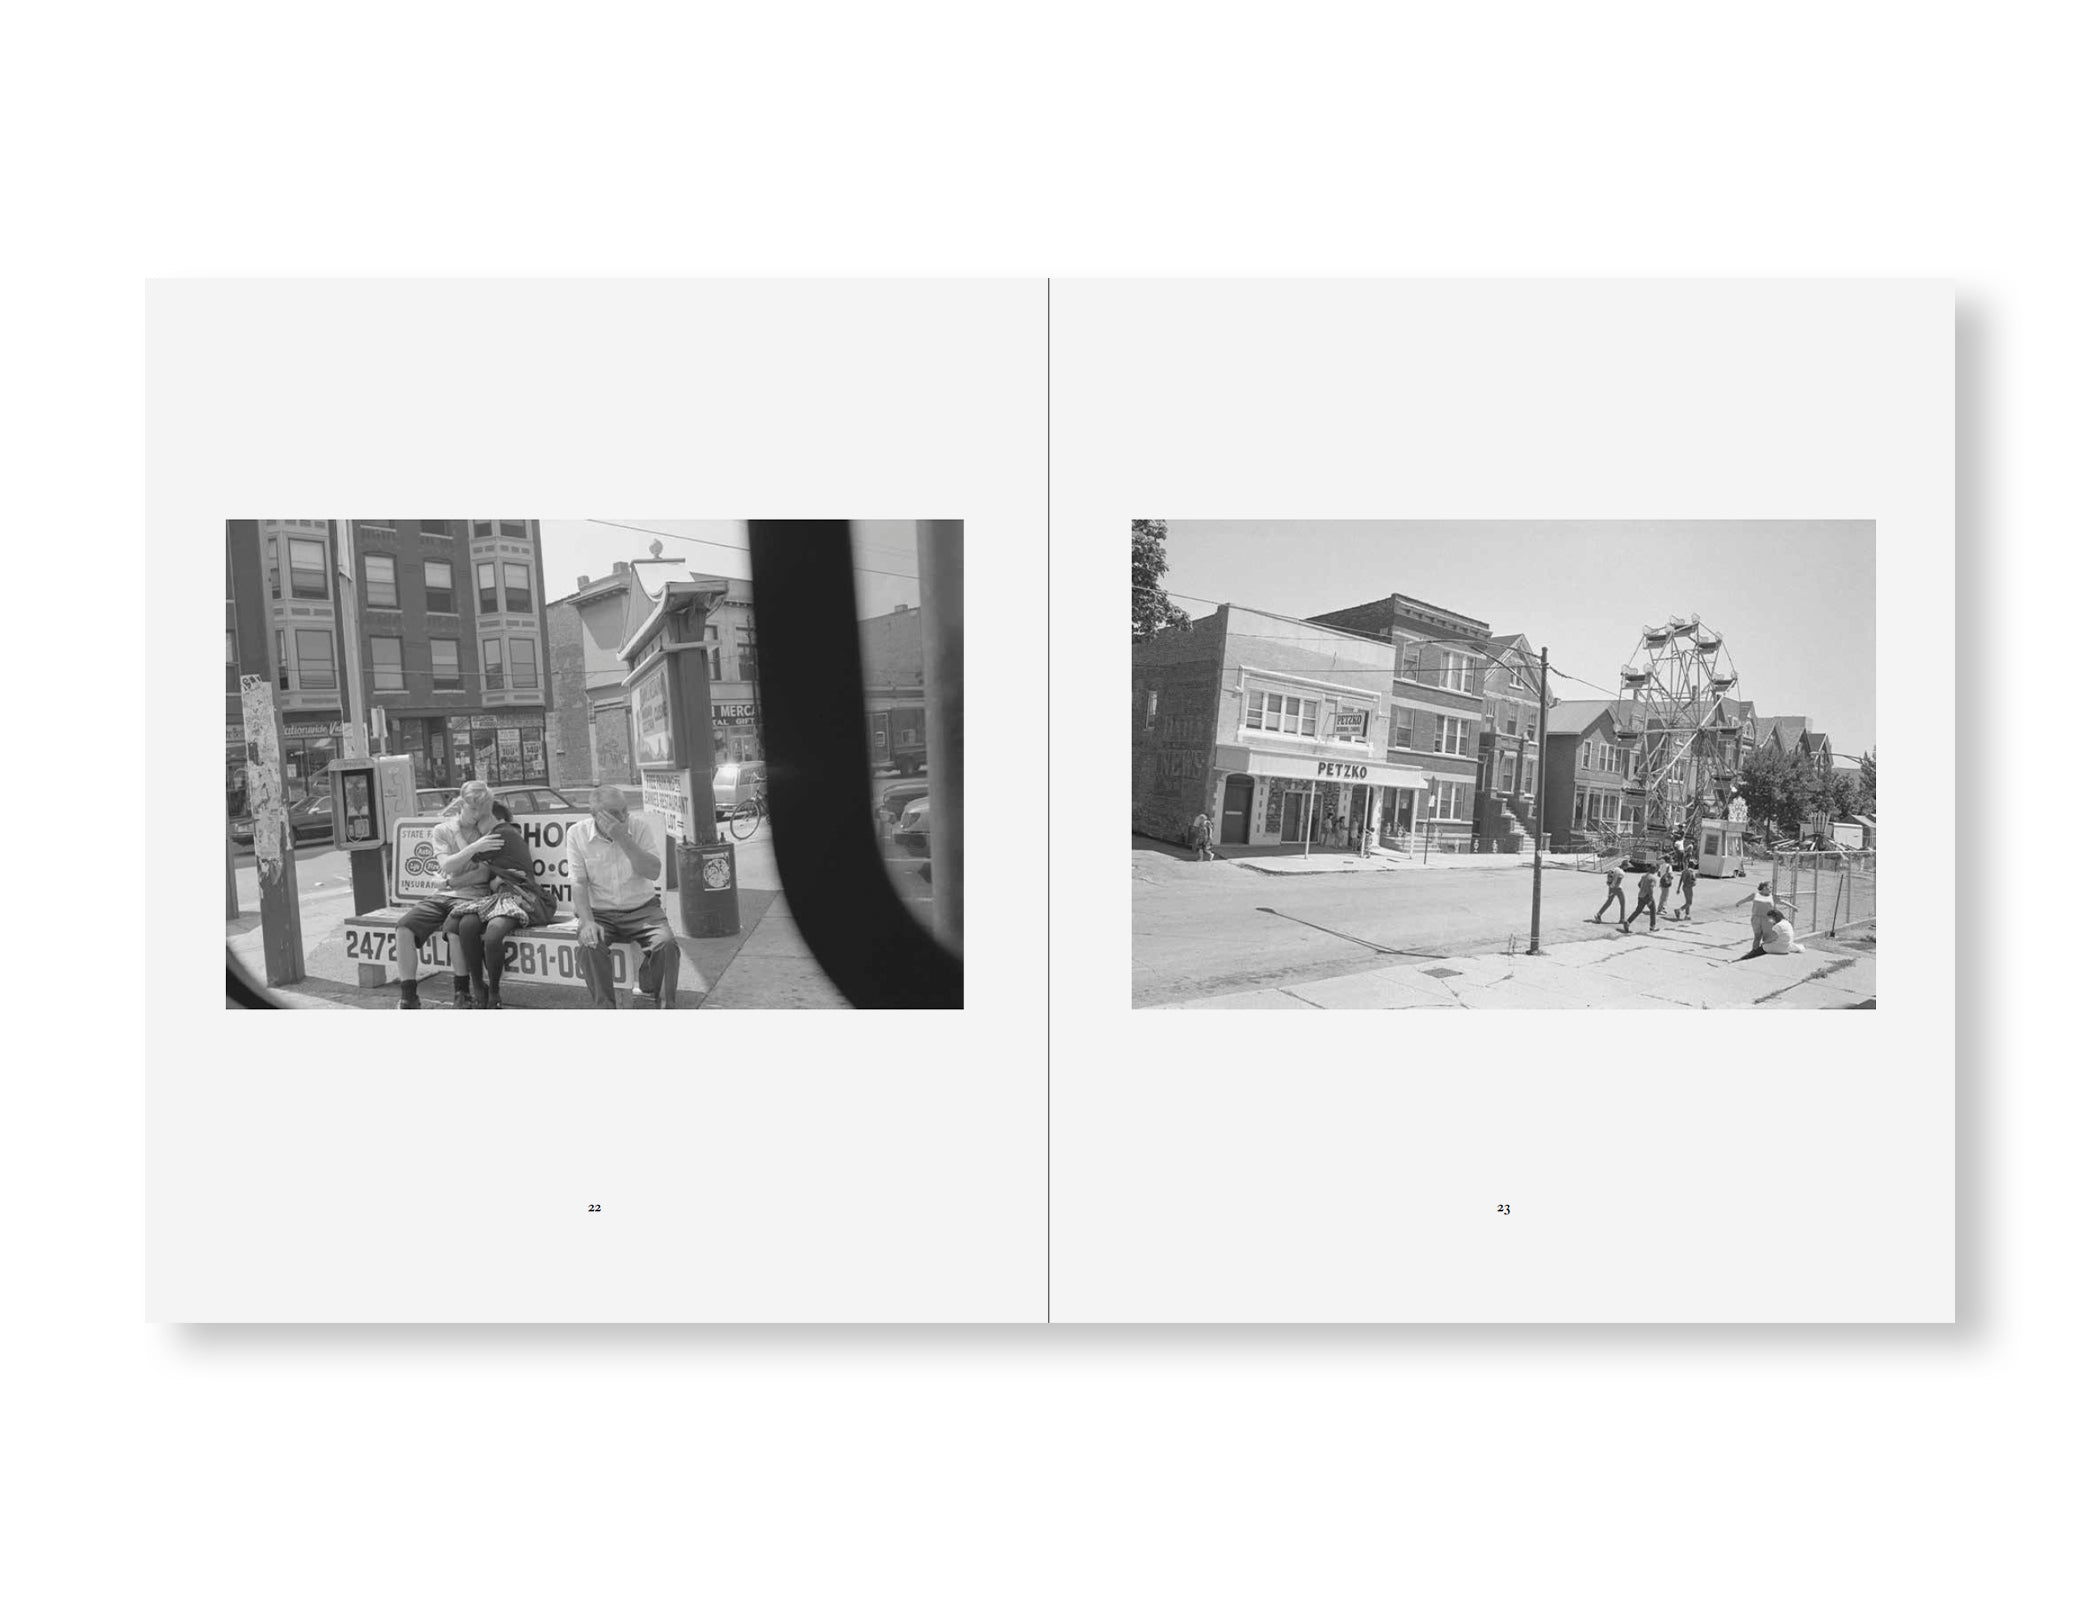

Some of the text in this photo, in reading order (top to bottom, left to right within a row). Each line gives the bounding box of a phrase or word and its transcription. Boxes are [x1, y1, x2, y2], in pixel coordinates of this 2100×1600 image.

[1337, 714, 1362, 726] PETZKO
[282, 723, 328, 735] ationwide
[1318, 761, 1367, 779] PETZKO
[401, 830, 423, 839] STATE
[346, 930, 397, 961] 2472
[588, 1204, 601, 1212] 22
[1497, 1204, 1511, 1215] 23
